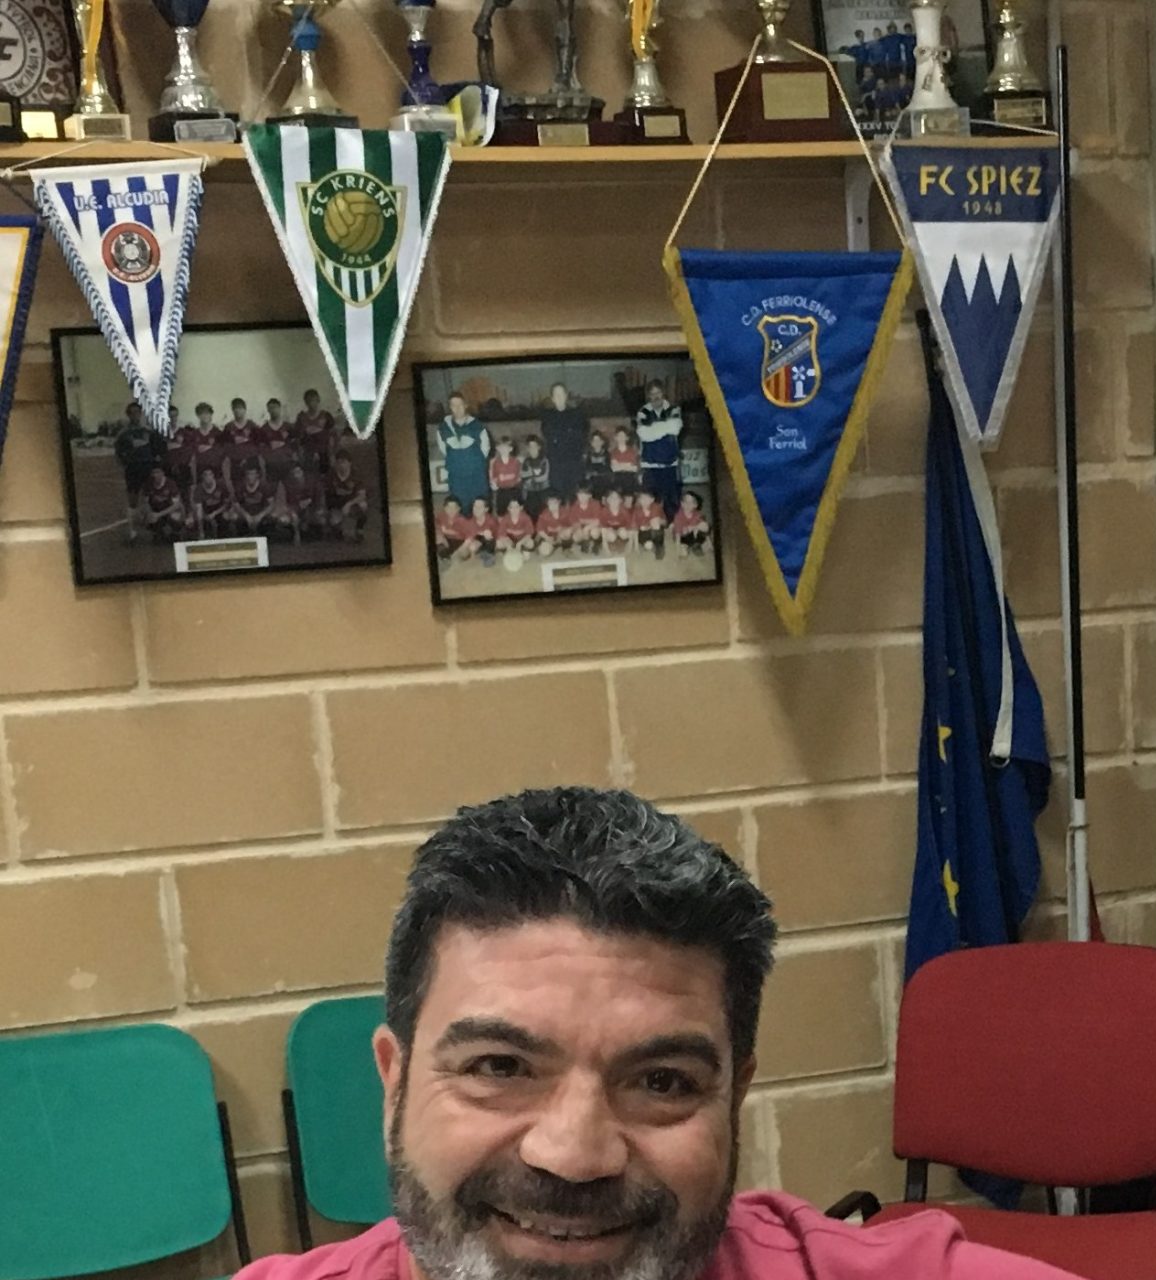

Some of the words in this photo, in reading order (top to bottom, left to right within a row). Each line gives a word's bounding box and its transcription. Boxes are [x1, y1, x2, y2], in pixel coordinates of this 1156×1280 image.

[919, 164, 955, 196] FC
[966, 164, 1042, 196] SPIEZ
[106, 189, 169, 209] ALCUDIA
[311, 191, 328, 216] SC
[330, 175, 395, 218] KRIENS
[962, 200, 1003, 216] 1948
[761, 295, 837, 326] FERRIOLENSE
[777, 324, 802, 336] C.D.
